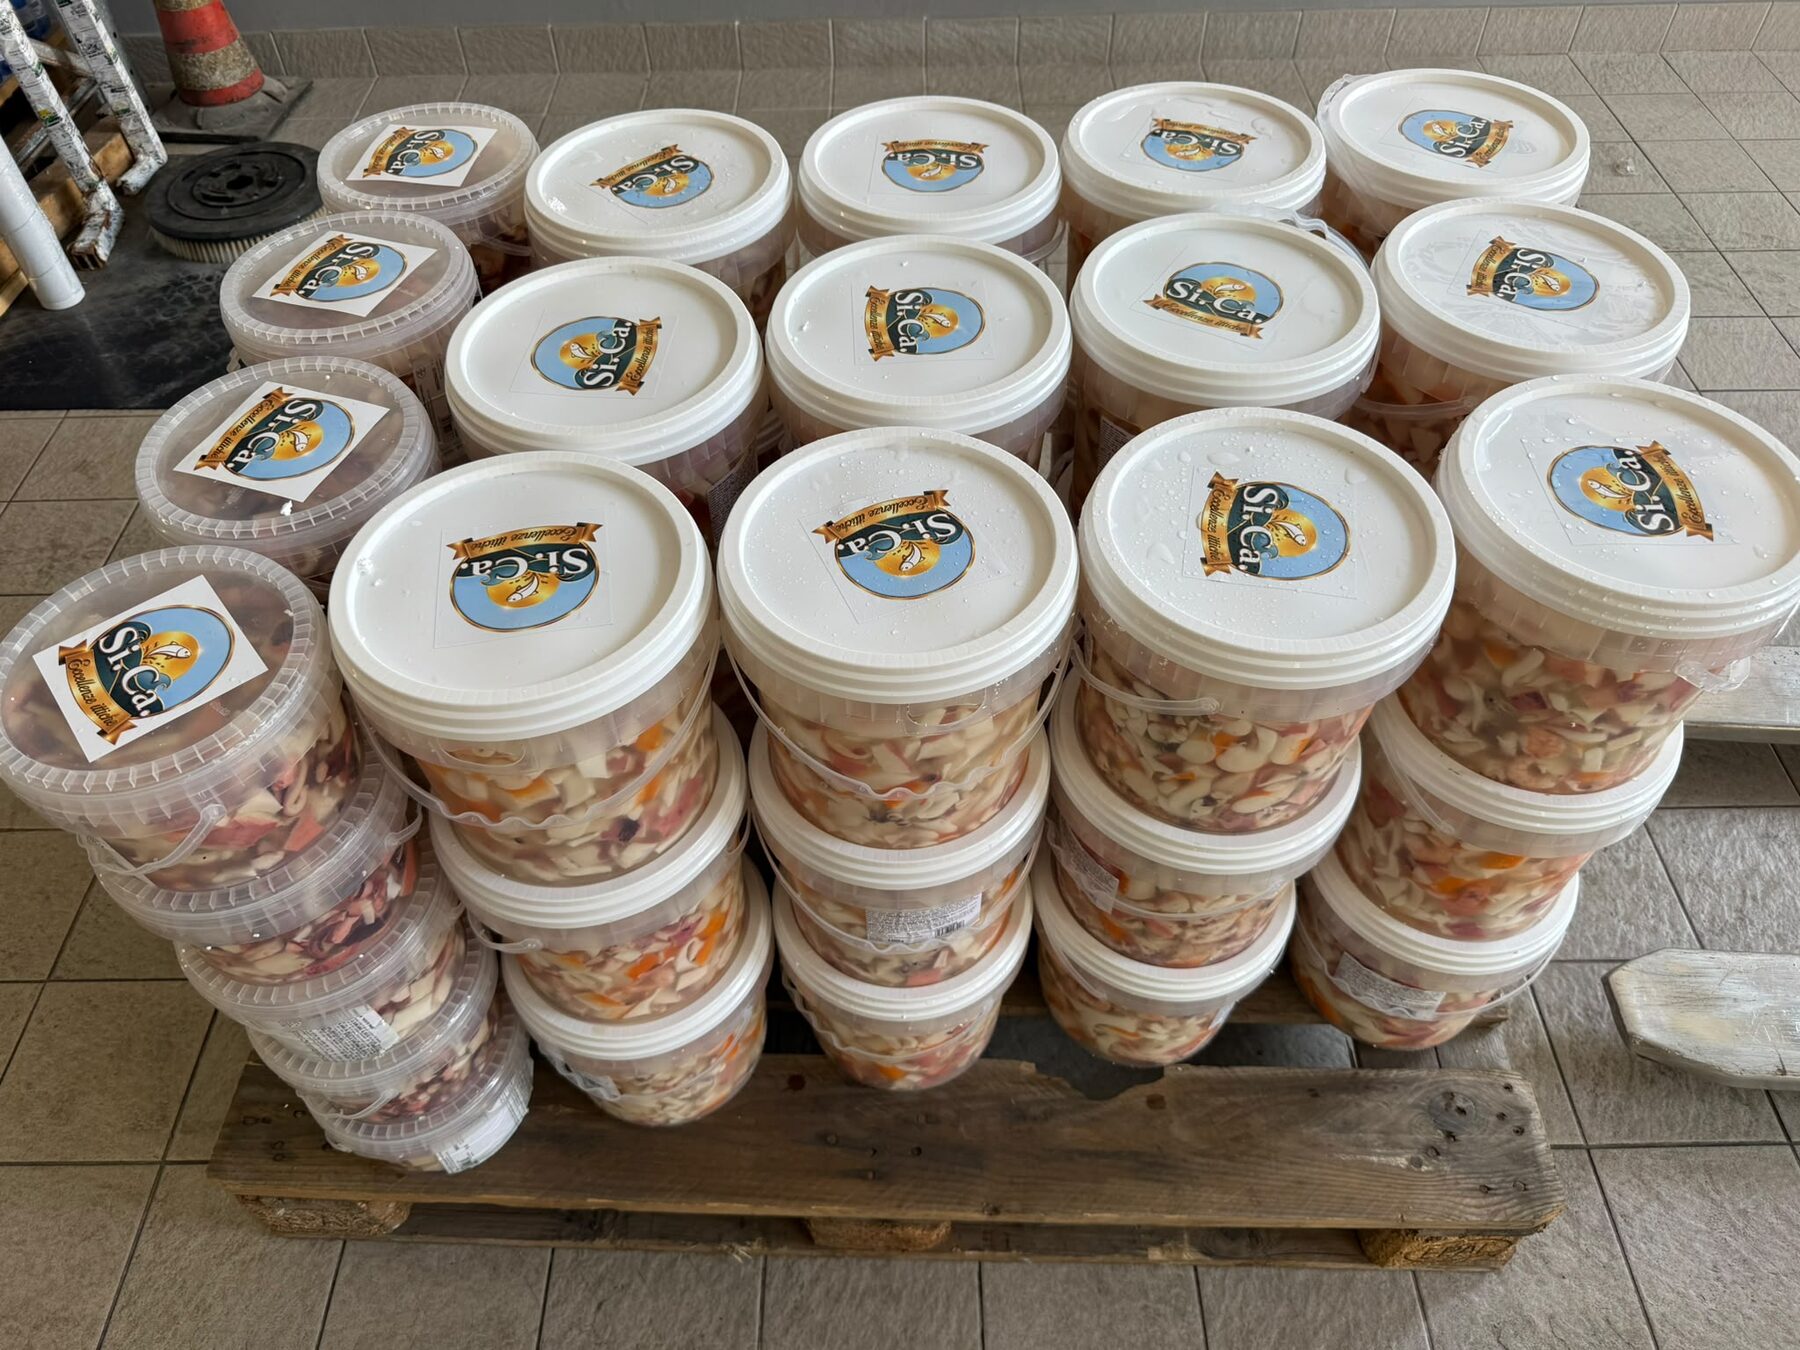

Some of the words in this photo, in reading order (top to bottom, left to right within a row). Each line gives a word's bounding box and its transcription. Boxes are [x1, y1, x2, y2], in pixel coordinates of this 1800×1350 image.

[231, 400, 274, 436] Eccellenze
[868, 495, 929, 517] Eccellenze
[1208, 489, 1231, 533] Eccellenze
[1674, 478, 1702, 524] Eccellenze
[511, 526, 577, 541] Eccellenze
[834, 514, 866, 531] ittiche
[470, 535, 507, 550] ittiche
[1207, 535, 1223, 561] ittiche
[68, 658, 97, 704] Eccellenze
[91, 702, 118, 726] ittiche
